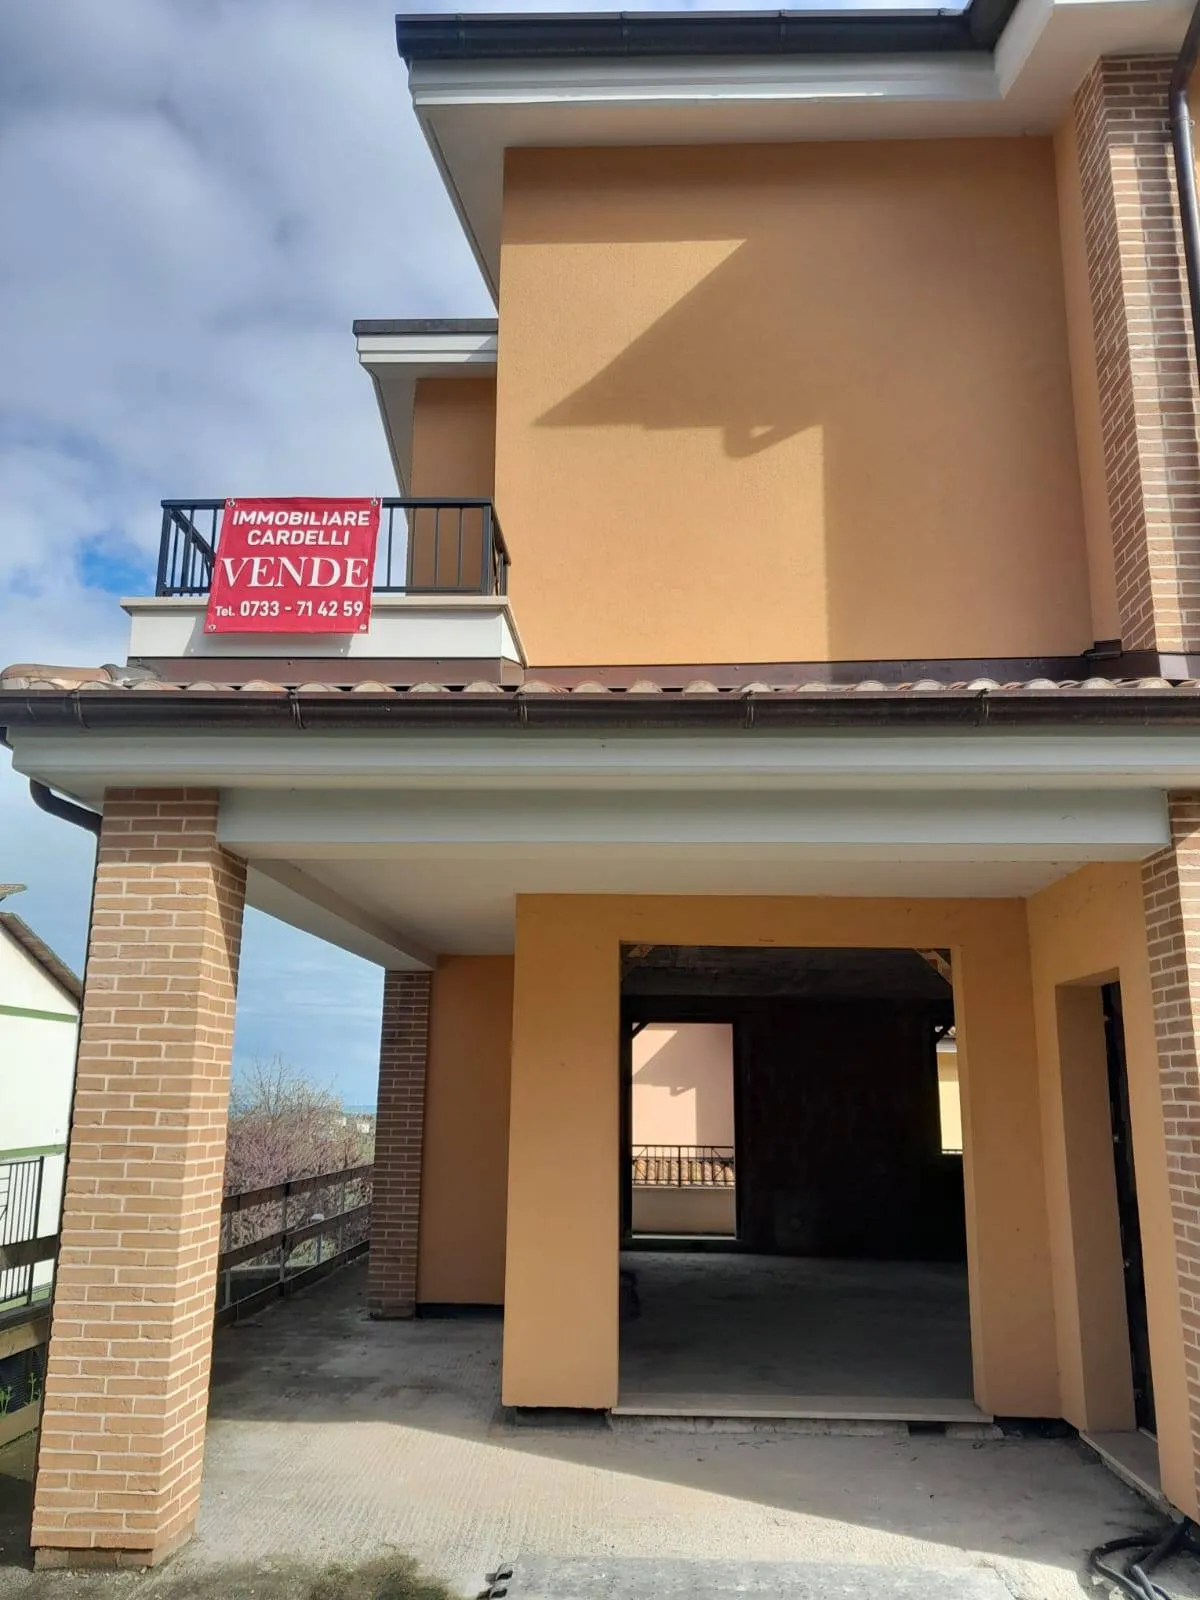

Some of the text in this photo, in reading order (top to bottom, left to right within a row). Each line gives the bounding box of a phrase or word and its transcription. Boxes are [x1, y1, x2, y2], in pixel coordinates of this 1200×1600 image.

[232, 511, 371, 526] IMMOBILIARE
[247, 530, 350, 546] CARDELLI
[220, 556, 369, 588] VENDE
[215, 605, 235, 617] Tel.
[240, 600, 280, 617] 0733
[297, 601, 312, 617] 71
[317, 601, 338, 617] 42
[343, 601, 364, 617] 59
